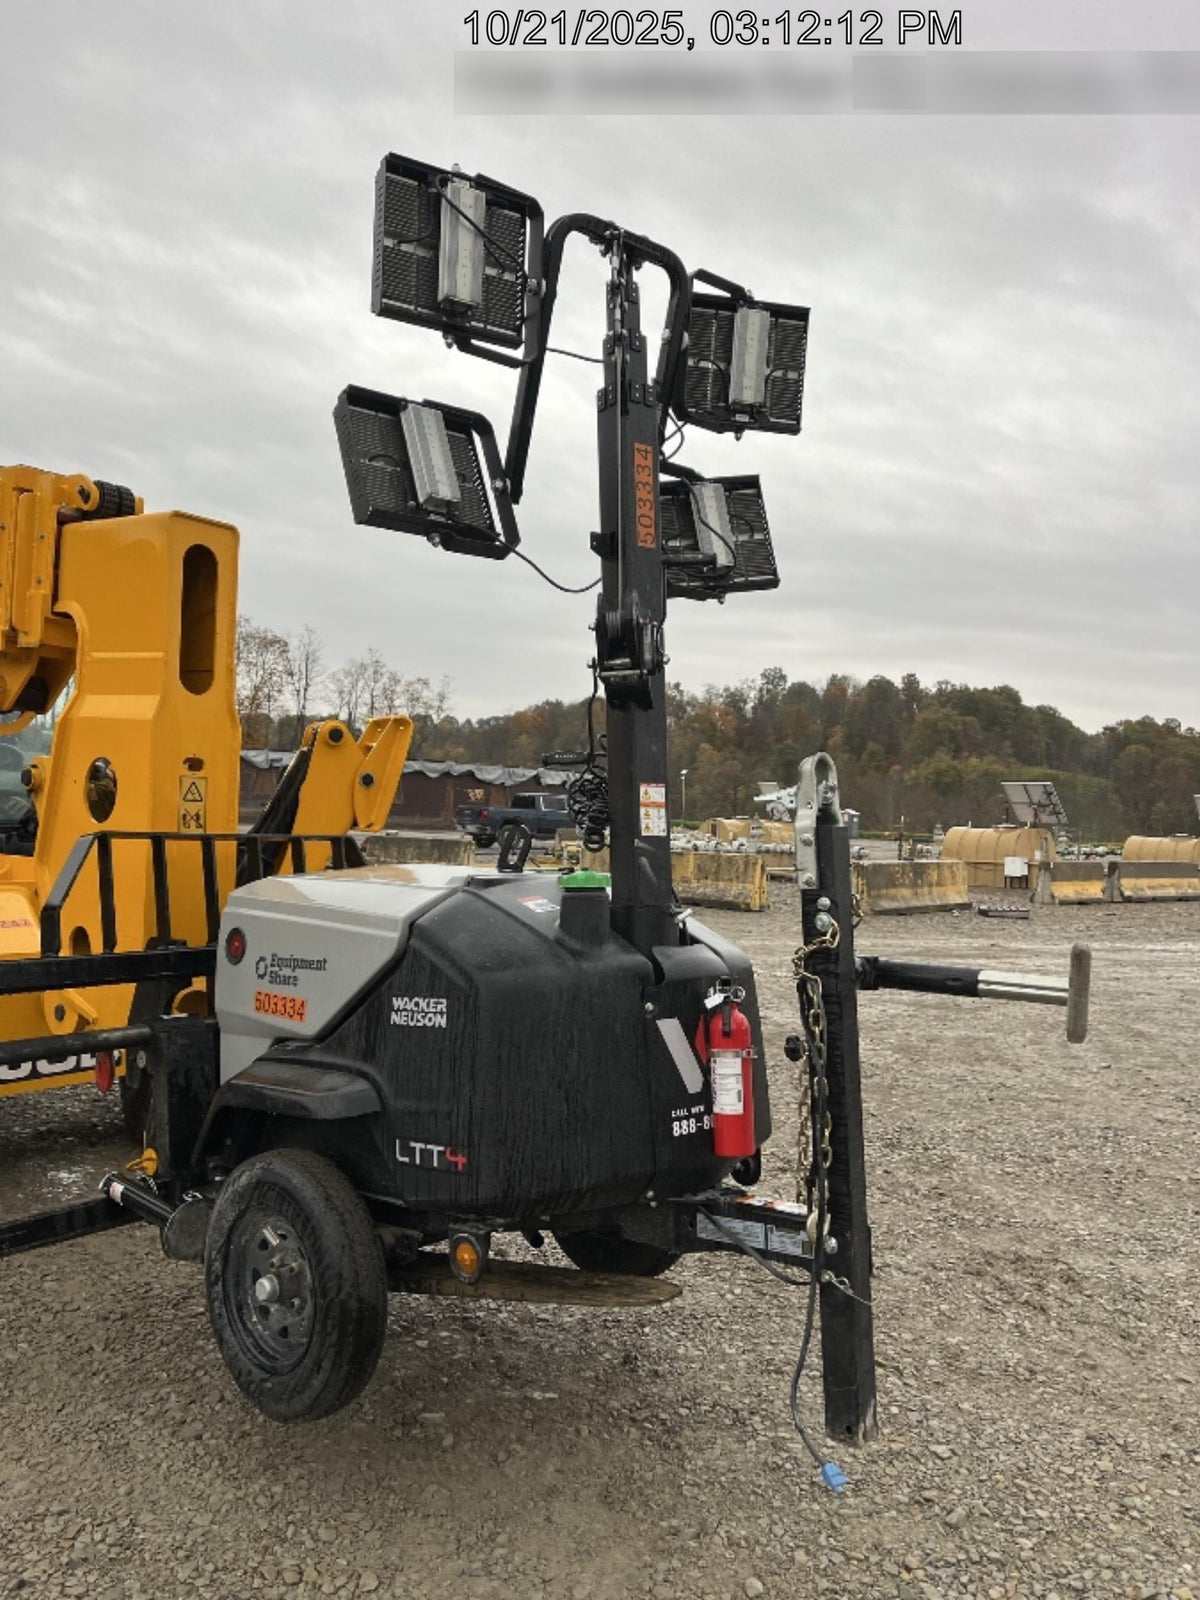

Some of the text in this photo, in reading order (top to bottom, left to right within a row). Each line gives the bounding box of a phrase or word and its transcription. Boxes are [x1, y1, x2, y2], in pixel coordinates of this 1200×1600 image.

[635, 446, 654, 545] 503334
[269, 953, 328, 972] Equipment
[268, 970, 299, 987] Share
[255, 991, 305, 1021] 503334
[392, 996, 447, 1012] WACKER
[390, 1010, 447, 1028] NEUSON
[395, 1138, 467, 1172] LTT4
